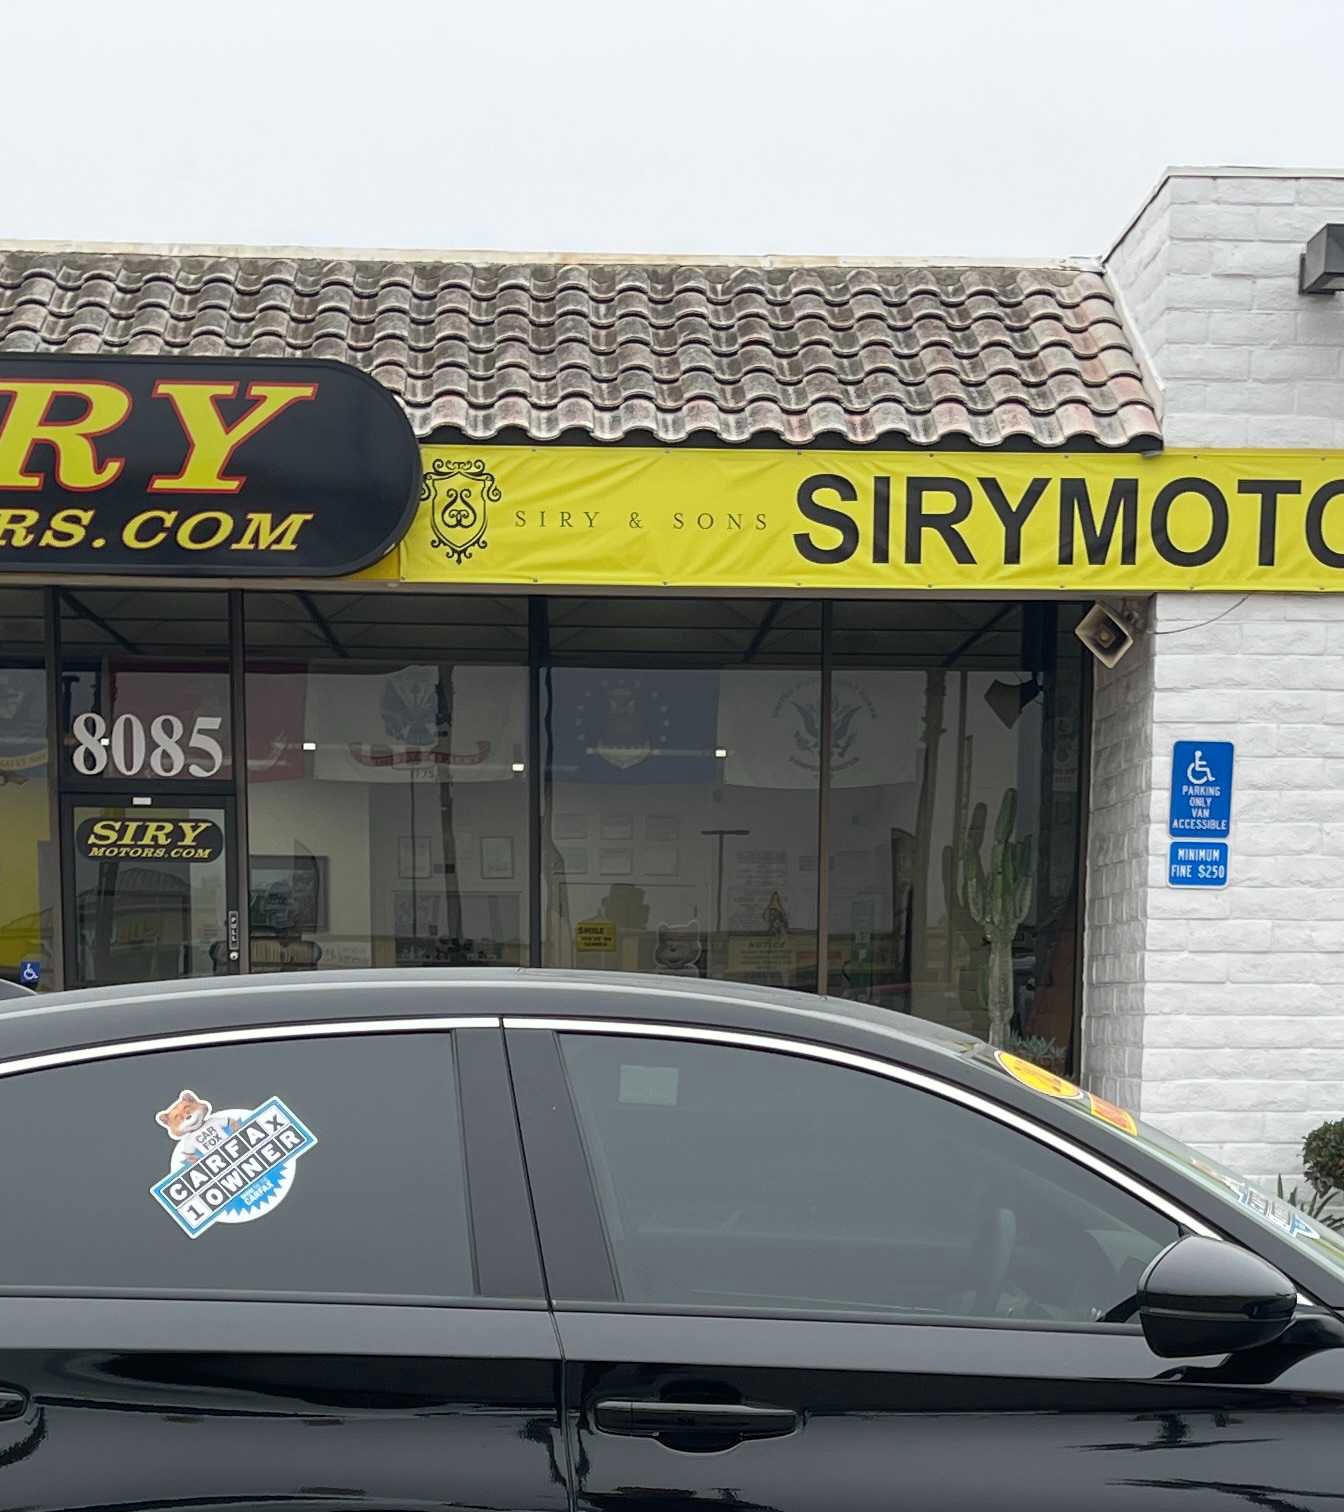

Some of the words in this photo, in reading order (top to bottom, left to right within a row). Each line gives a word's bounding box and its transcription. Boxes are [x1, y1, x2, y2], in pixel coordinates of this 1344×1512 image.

[514, 509, 601, 529] SIRY
[629, 511, 645, 529] &
[673, 511, 769, 531] SONS
[72, 712, 224, 778] 8085
[1181, 785, 1221, 797] PARKING
[1188, 797, 1212, 807] ONLY
[1191, 808, 1210, 818] VAN
[1171, 818, 1228, 830] ACCESSIBLE
[87, 820, 213, 846] SIRY
[87, 847, 213, 859] MOTORS.COM
[1177, 848, 1221, 862] MINIMUM
[1171, 864, 1193, 878] FINE
[1197, 864, 1225, 879] $250
[195, 1125, 217, 1145] CAR
[168, 1113, 285, 1202] CARFAX
[186, 1204, 205, 1222] 1
[205, 1129, 301, 1206] OWNER
